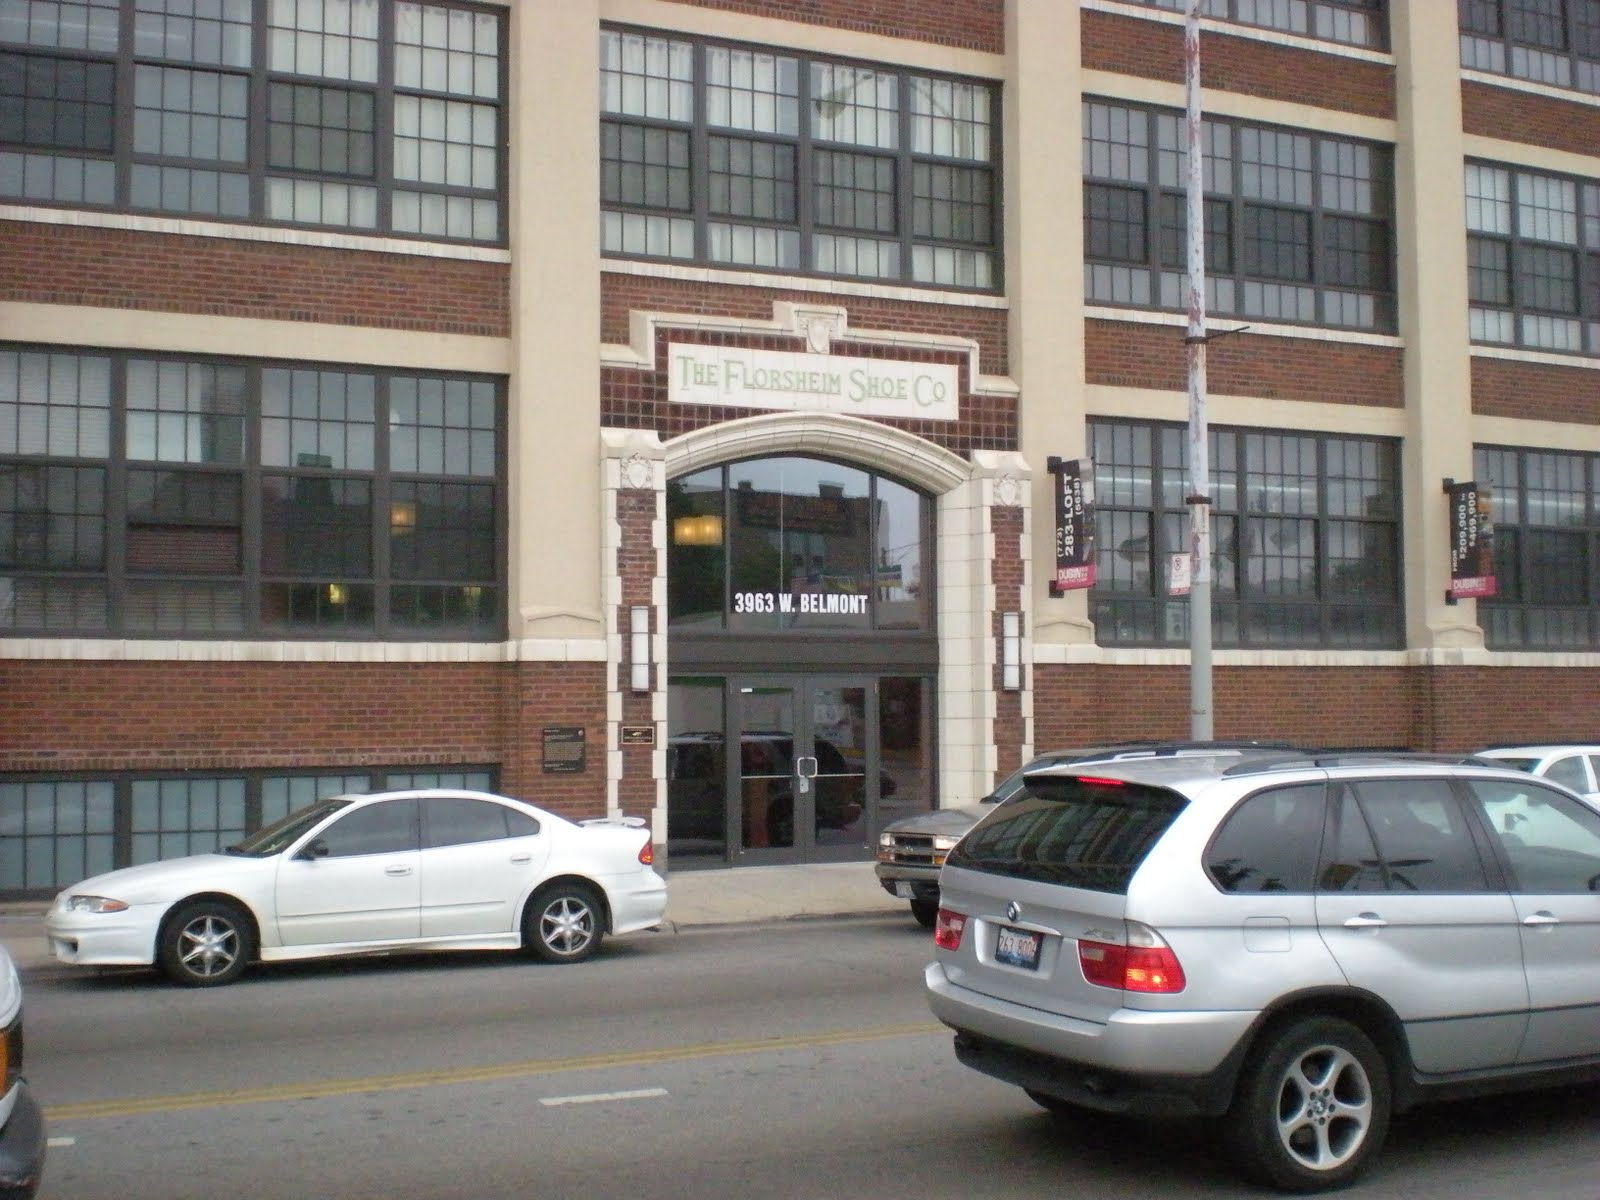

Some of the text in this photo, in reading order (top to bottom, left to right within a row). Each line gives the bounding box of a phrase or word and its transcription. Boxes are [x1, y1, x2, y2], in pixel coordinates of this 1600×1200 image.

[723, 359, 842, 396] FLORSHEIM
[849, 368, 908, 402] SHOE
[1063, 472, 1074, 557] 283-LOFT
[1058, 567, 1081, 580] DUBIN
[734, 592, 868, 614] 3963 W. BELMONT
